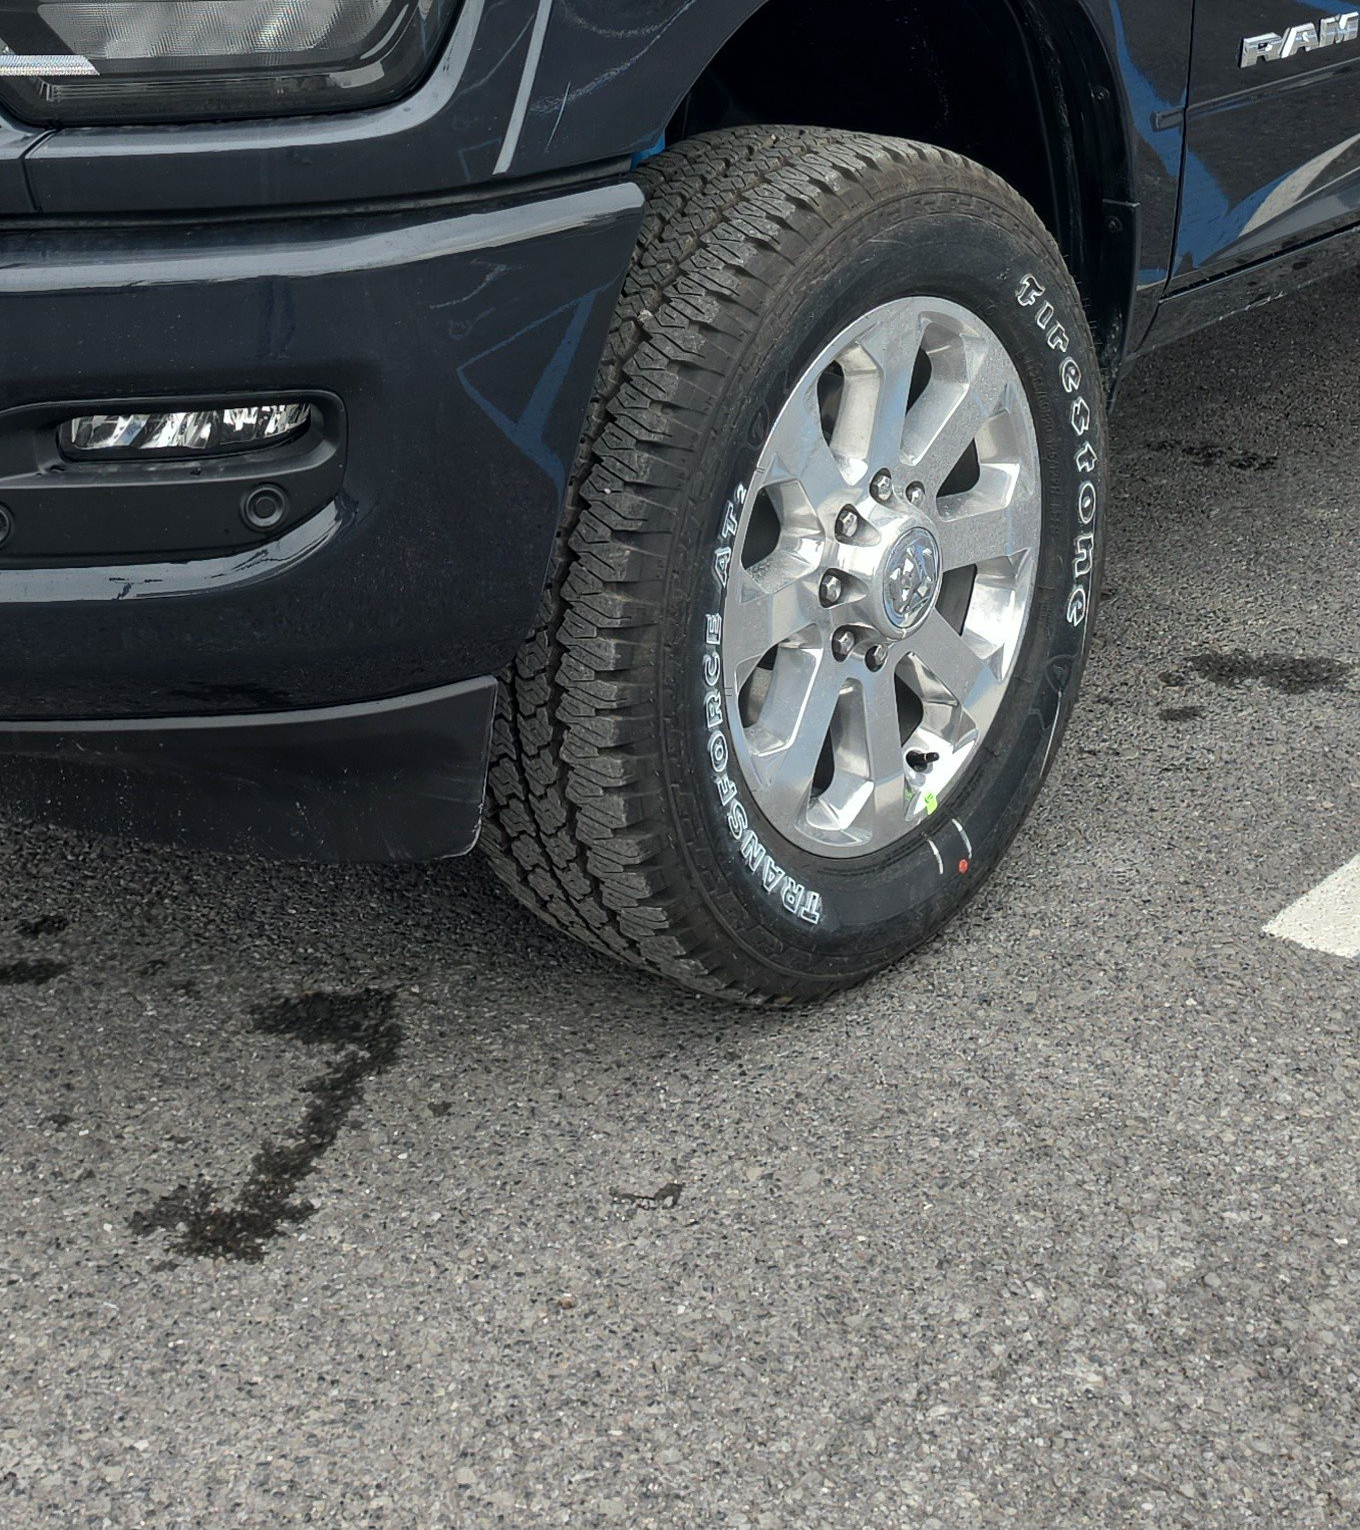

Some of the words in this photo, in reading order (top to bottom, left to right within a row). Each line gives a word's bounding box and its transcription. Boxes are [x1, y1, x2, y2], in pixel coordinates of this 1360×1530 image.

[1238, 11, 1359, 69] RAM
[1014, 274, 1098, 627] Firestone
[702, 612, 822, 925] TRANSFORCE
